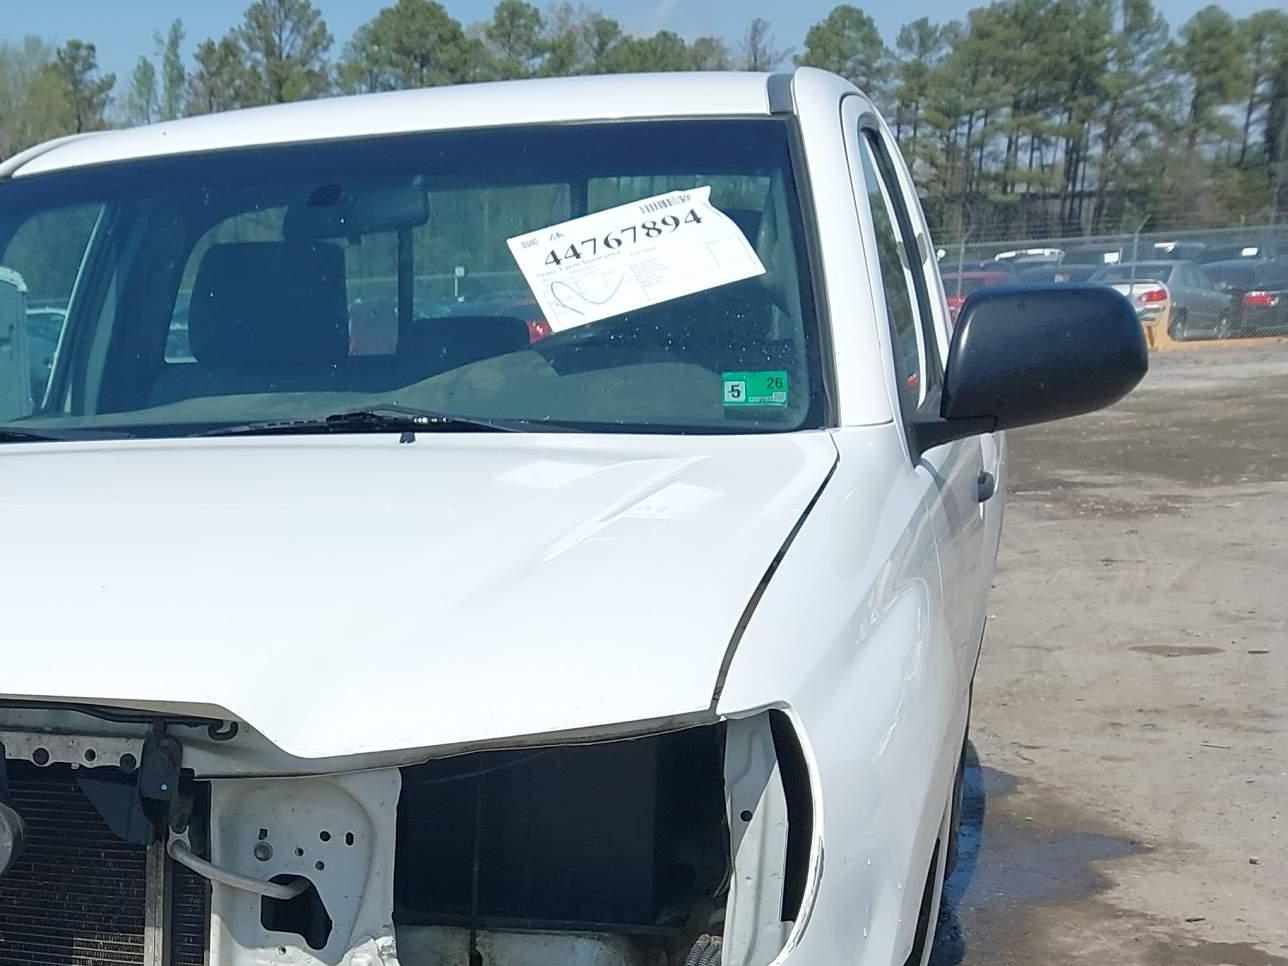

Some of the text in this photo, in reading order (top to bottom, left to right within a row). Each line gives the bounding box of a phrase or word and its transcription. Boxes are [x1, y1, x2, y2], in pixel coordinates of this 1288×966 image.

[545, 209, 702, 267] 44767894
[766, 377, 784, 390] 26
[728, 384, 741, 399] 5
